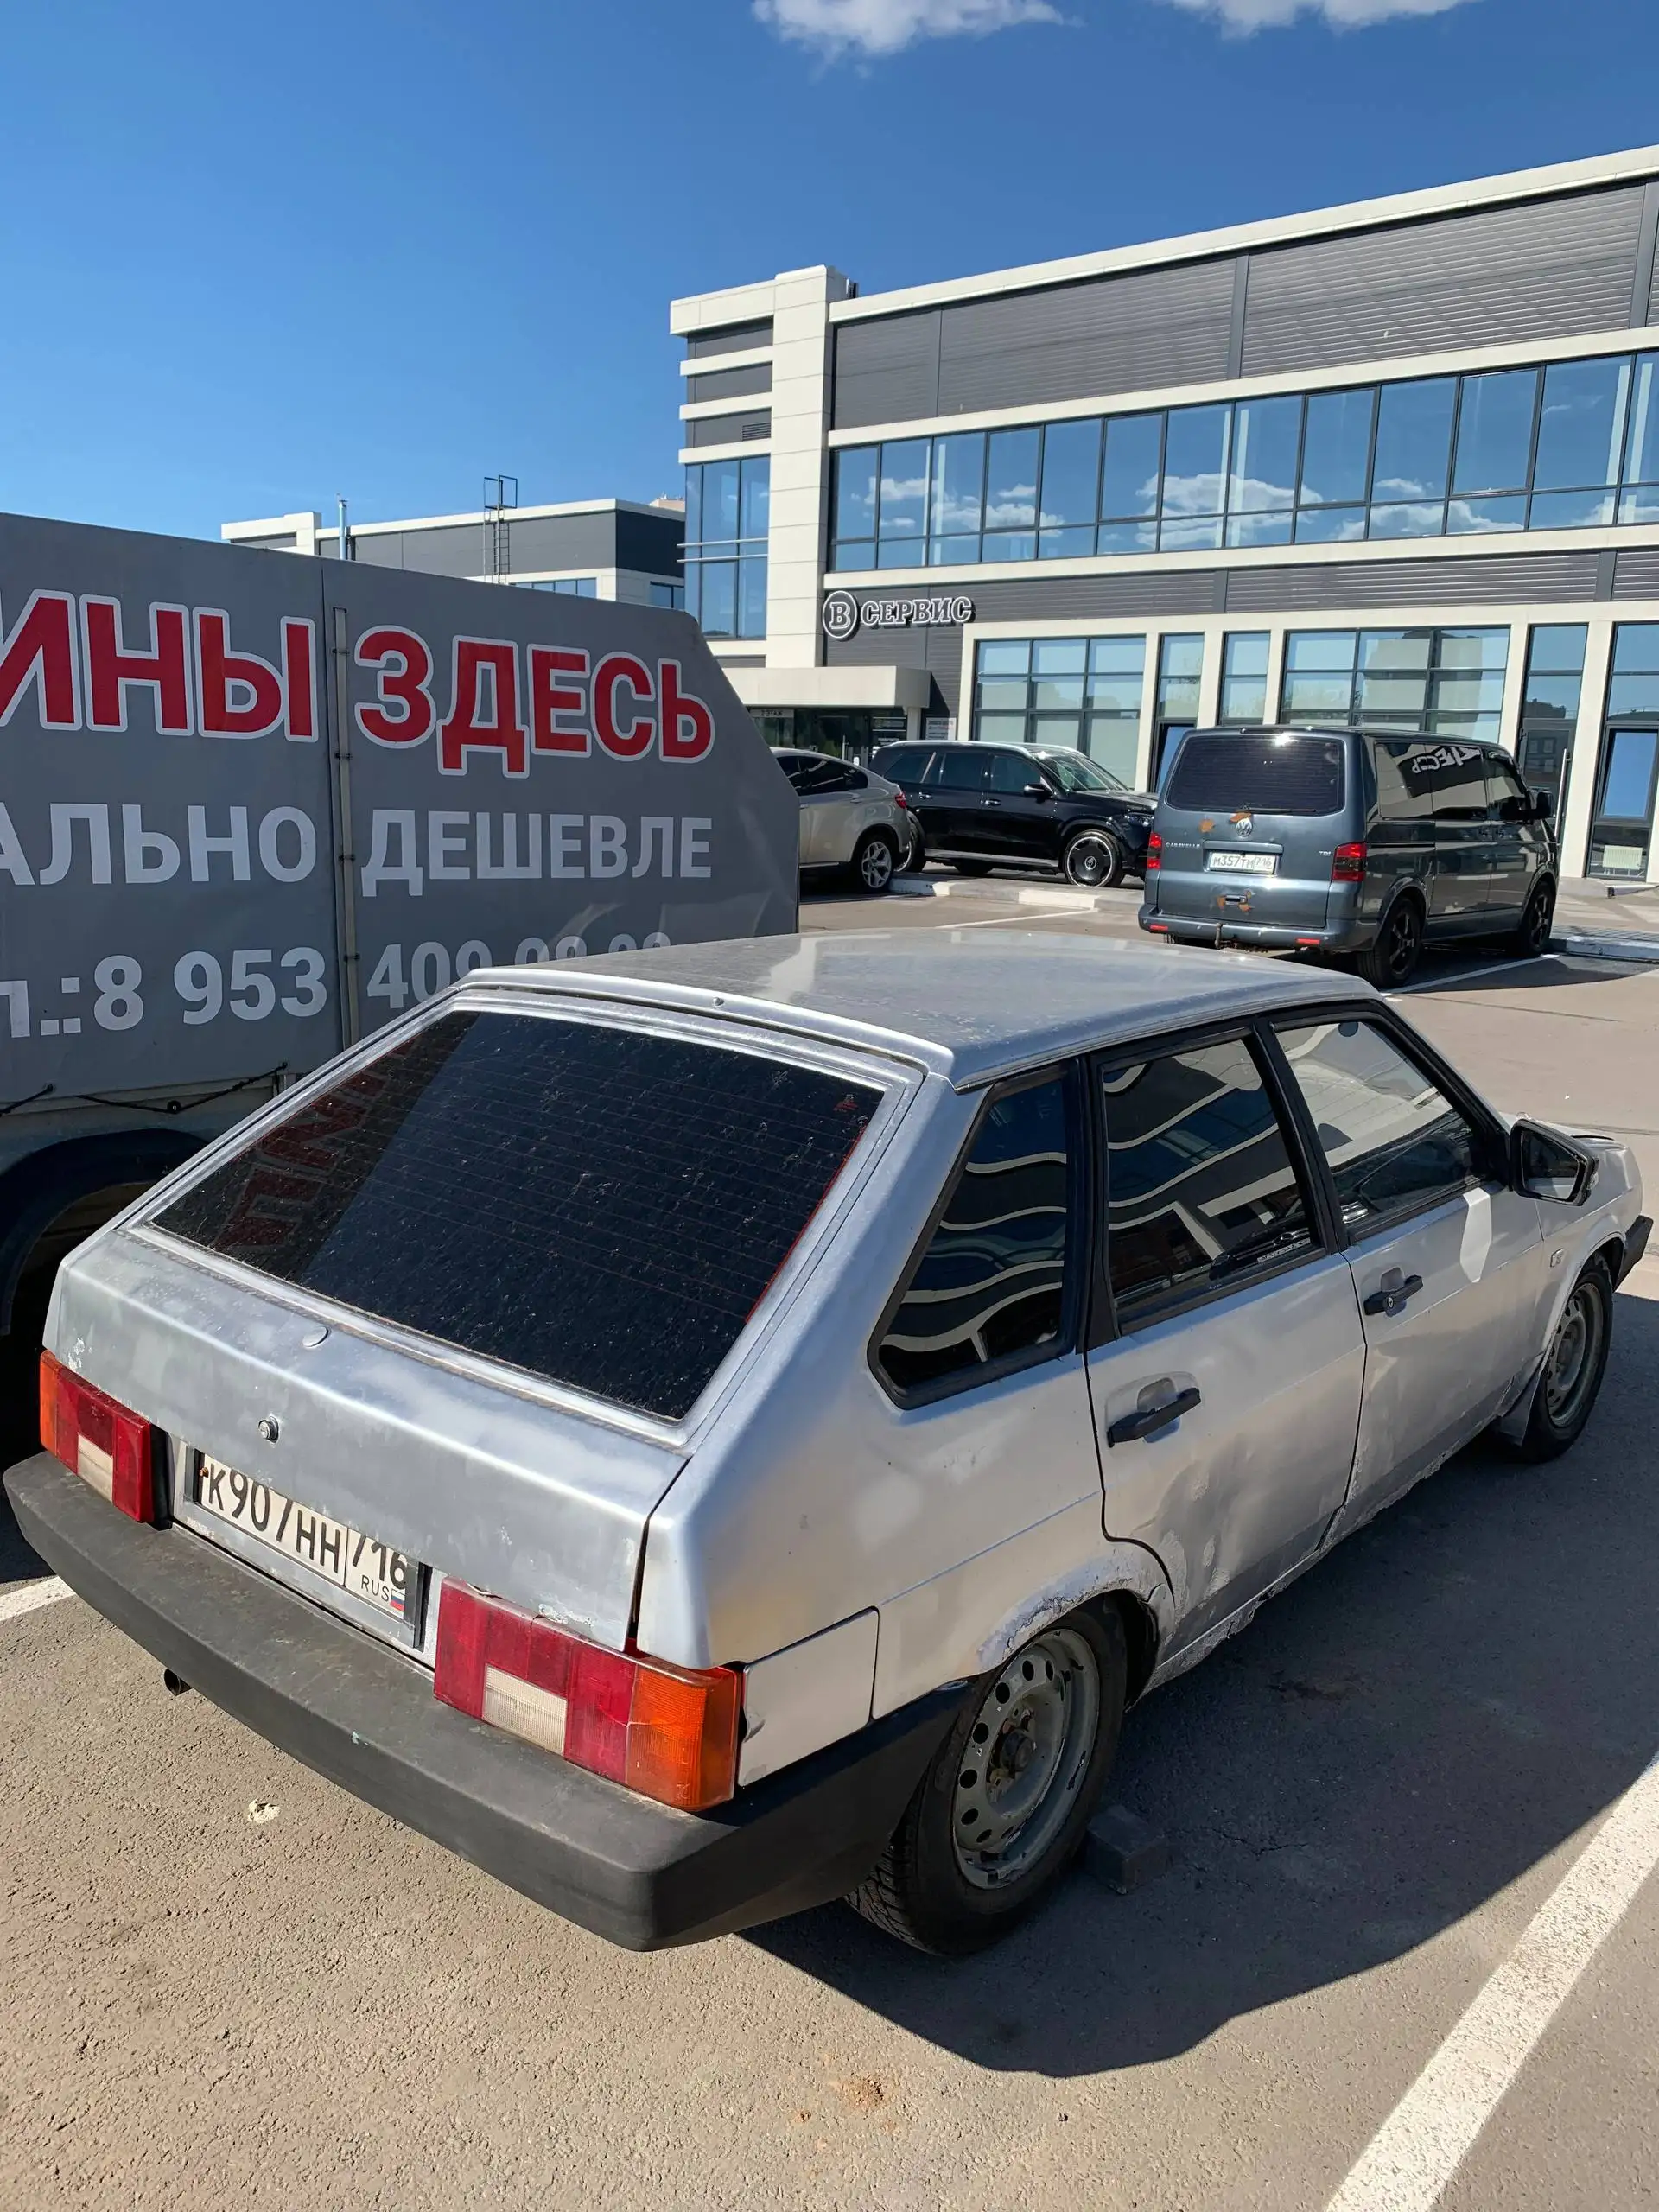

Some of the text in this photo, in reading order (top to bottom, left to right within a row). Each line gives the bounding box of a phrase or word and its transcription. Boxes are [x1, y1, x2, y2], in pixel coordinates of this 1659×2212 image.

[860, 595, 975, 626] СЕРВИС
[354, 625, 715, 779] ЗДЕСЬ
[361, 809, 712, 897] ДЕШЕВЛЕ
[174, 947, 327, 1026] 953
[360, 1574, 391, 1602] RUS
